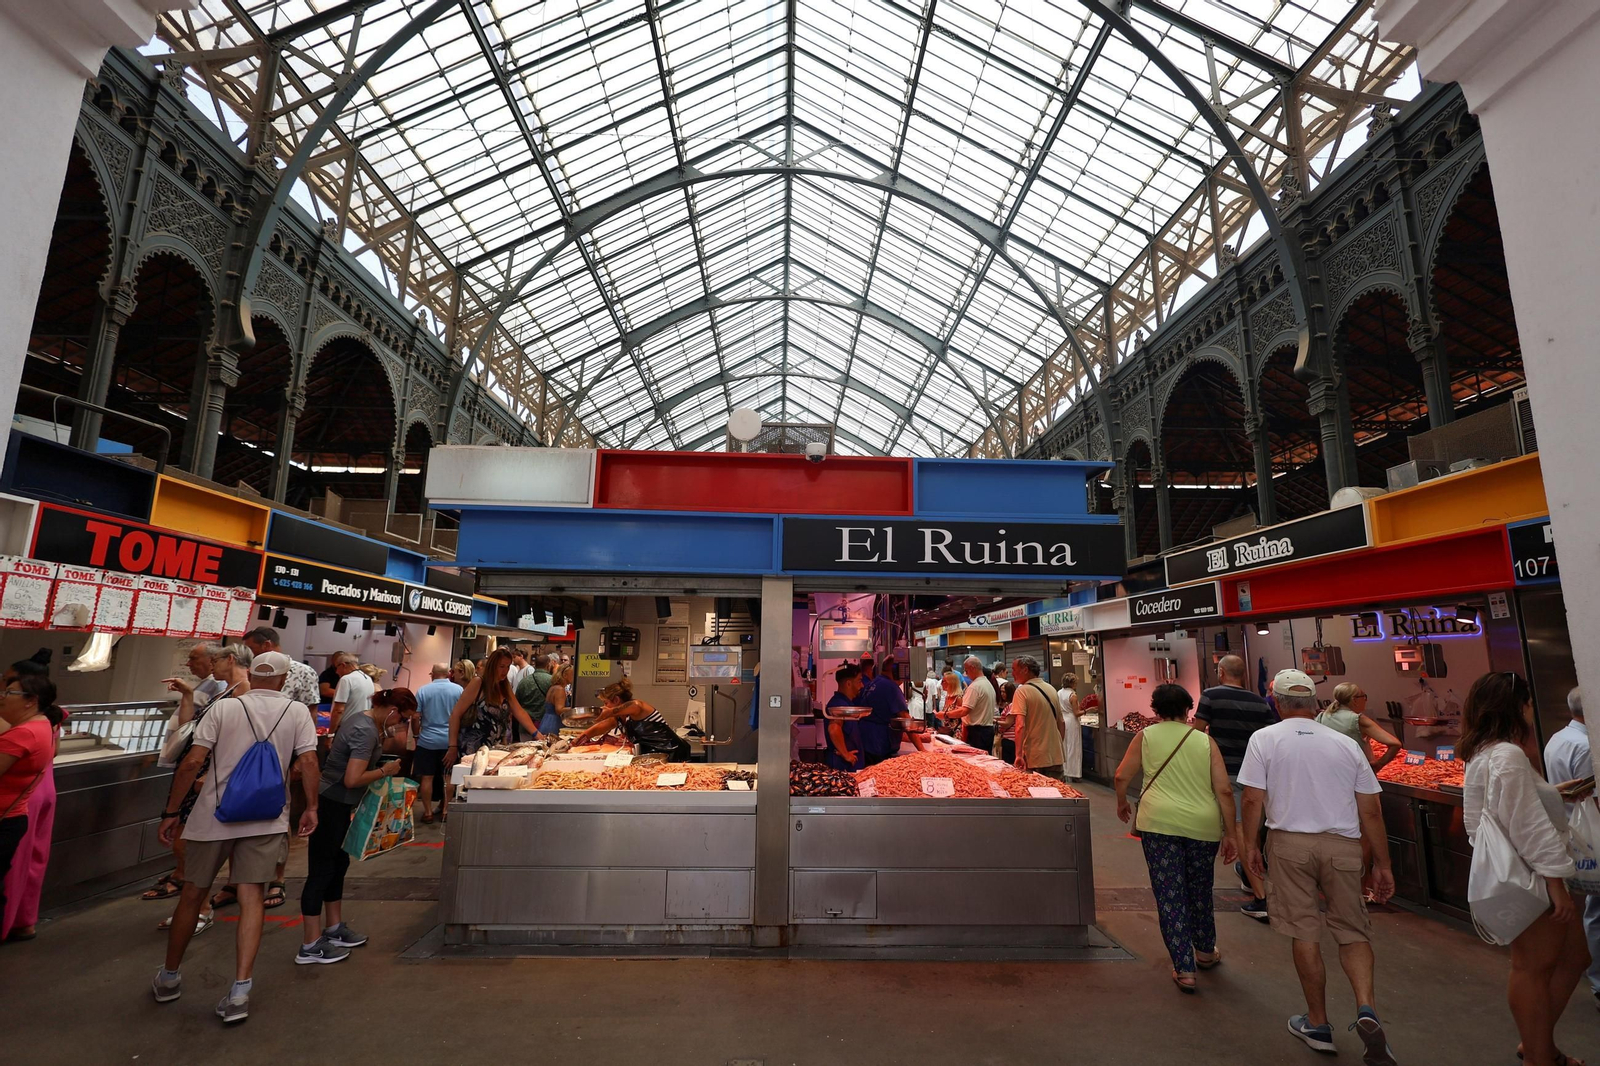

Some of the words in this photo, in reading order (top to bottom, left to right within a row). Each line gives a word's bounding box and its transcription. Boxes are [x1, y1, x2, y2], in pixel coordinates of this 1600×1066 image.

[86, 519, 223, 584] TOME
[835, 526, 898, 563] El
[917, 527, 1077, 566] Ruina
[1206, 546, 1229, 573] El
[1234, 536, 1294, 567] Ruina
[13, 562, 51, 577] TOME
[64, 569, 96, 582] TOME
[1514, 555, 1550, 578] 107
[105, 575, 134, 588] TOME
[143, 580, 169, 592] TOME
[176, 584, 198, 596] TOM
[206, 589, 227, 599] TOME
[321, 579, 361, 598] Pescados
[362, 587, 369, 602] y
[369, 587, 402, 605] Mariscos
[421, 596, 444, 613] HNOS.
[444, 598, 472, 617] CÉSPEDES
[1136, 596, 1182, 616] Cocedero
[1041, 610, 1074, 627] CURRI
[1388, 609, 1478, 636] Ruina
[926, 780, 935, 794] 8
